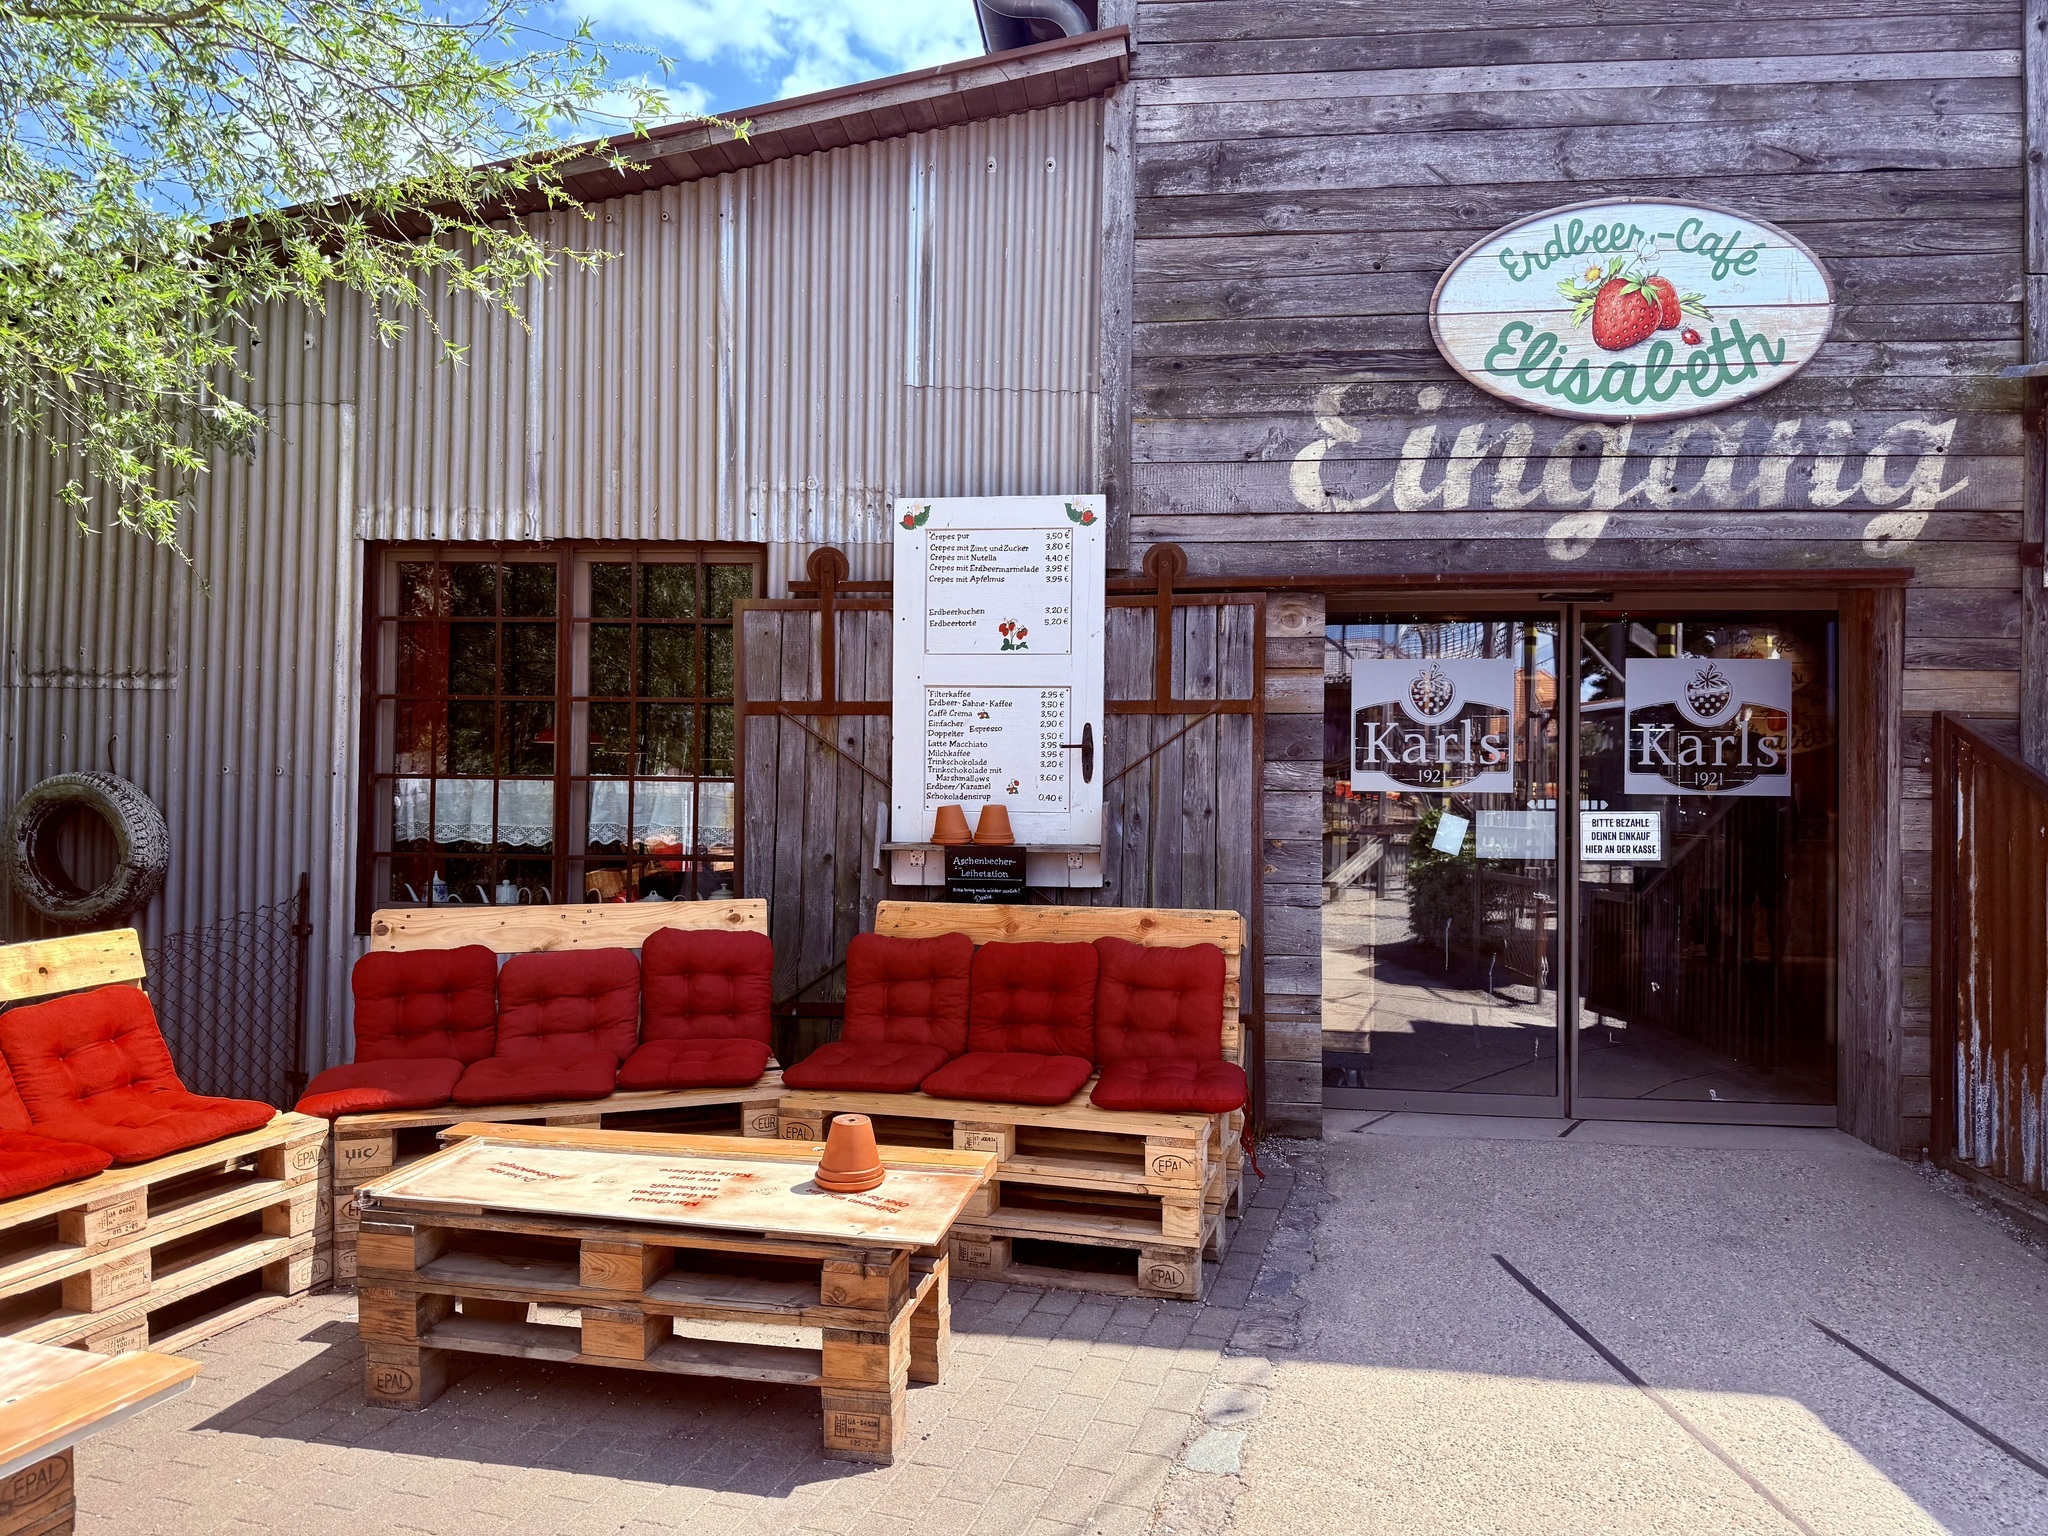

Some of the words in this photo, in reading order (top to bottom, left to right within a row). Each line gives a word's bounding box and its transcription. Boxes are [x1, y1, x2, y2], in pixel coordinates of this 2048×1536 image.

[1484, 318, 1785, 405] Elisabeth
[1288, 376, 1971, 561] Eingang
[929, 533, 955, 542] Crepes
[957, 533, 970, 541] pur
[1045, 532, 1063, 540] 3,50
[930, 544, 955, 552] Crepes
[1045, 543, 1064, 551] 3,80
[1065, 542, 1070, 550] €
[930, 554, 955, 562] Crepes
[970, 554, 997, 562] Nutella
[1045, 554, 1063, 563] 4,40
[929, 564, 955, 572] Crepes
[969, 564, 1040, 573] Erdbeermarmelade
[1045, 564, 1063, 573] 3,95
[929, 575, 954, 584] Crepes
[956, 575, 968, 583] mit
[969, 575, 1005, 585] Apfelmus
[1045, 575, 1063, 583] 3,95
[929, 608, 985, 616] Erdbeerkuchen
[1044, 607, 1062, 615] 3,20
[1044, 618, 1062, 626] 5,20
[1040, 691, 1058, 699] 2,95
[1040, 701, 1058, 709] 3,50
[969, 725, 1003, 734] Espresso
[927, 730, 965, 739] Doppelter
[1040, 732, 1057, 740] 3,50
[948, 740, 988, 748] Macchiato
[1363, 718, 1501, 765] Karls
[1637, 720, 1779, 768] Karls
[927, 758, 988, 766] Trinkschokolade
[936, 774, 990, 782] Marshmallows
[1039, 774, 1057, 782] 3,60
[1418, 769, 1447, 783] 1921
[1694, 772, 1723, 786] 1921
[926, 793, 991, 801] Schokoladensirup
[1038, 794, 1056, 802] 0,40
[1591, 819, 1614, 827] BITTE
[1615, 818, 1650, 827] BEZAHLE
[1591, 832, 1617, 841] DEINEN
[1619, 832, 1651, 841] EINKAUF
[1585, 845, 1602, 854] HIER
[1604, 845, 1614, 854] AN
[1616, 845, 1630, 854] DER
[1632, 845, 1657, 854] KASSE
[952, 856, 1017, 866] Aschenbecher-
[961, 869, 1009, 878] Leihstation
[758, 1117, 776, 1129] EUR
[786, 1126, 809, 1140] EPAL
[297, 1148, 322, 1168] EPAL
[377, 1373, 407, 1390] EPAL
[13, 1463, 60, 1501] EPAL
